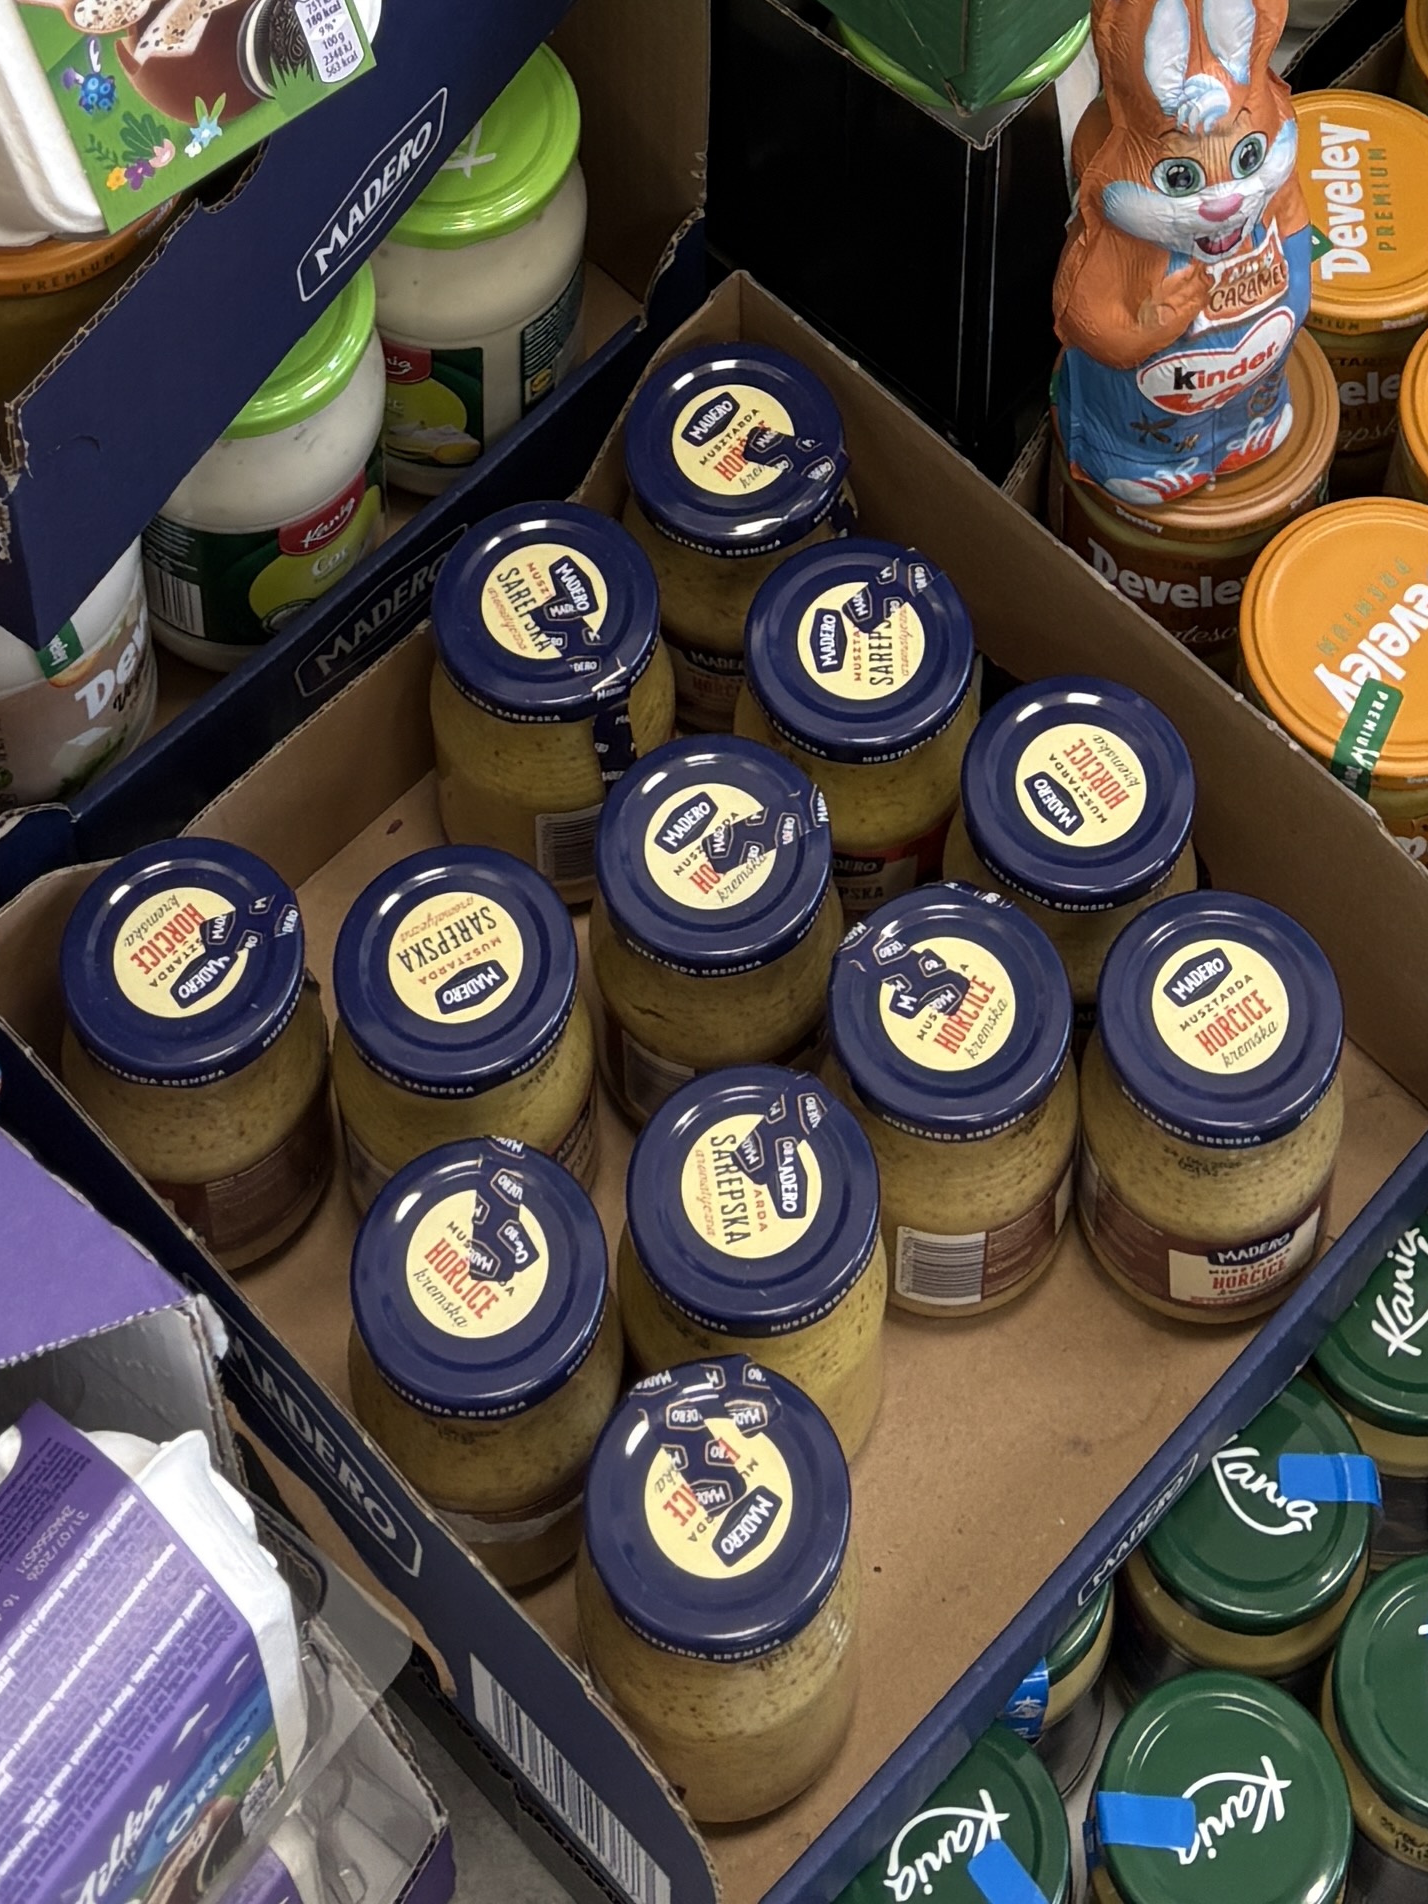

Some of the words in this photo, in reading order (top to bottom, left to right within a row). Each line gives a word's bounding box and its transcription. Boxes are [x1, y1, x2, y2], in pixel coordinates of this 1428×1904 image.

[314, 118, 433, 275] MADERO
[1311, 121, 1371, 280] Develey
[1209, 261, 1288, 311] CARAMEL
[1173, 341, 1278, 390] Kinder
[687, 400, 734, 441] MADERO
[662, 801, 710, 849] MADERO
[1033, 777, 1077, 829] MADERO
[397, 906, 497, 974] SAREPSKA
[418, 935, 503, 985] MUSZTARDA
[441, 967, 500, 1006] MADERO
[1171, 956, 1227, 1001] MADERO
[1179, 974, 1254, 1031] MUSZTARDA
[966, 997, 1008, 1060] kremska
[1221, 1020, 1277, 1068] kremska
[710, 1133, 751, 1246] SAREPSKA
[721, 1495, 772, 1555] MADERO
